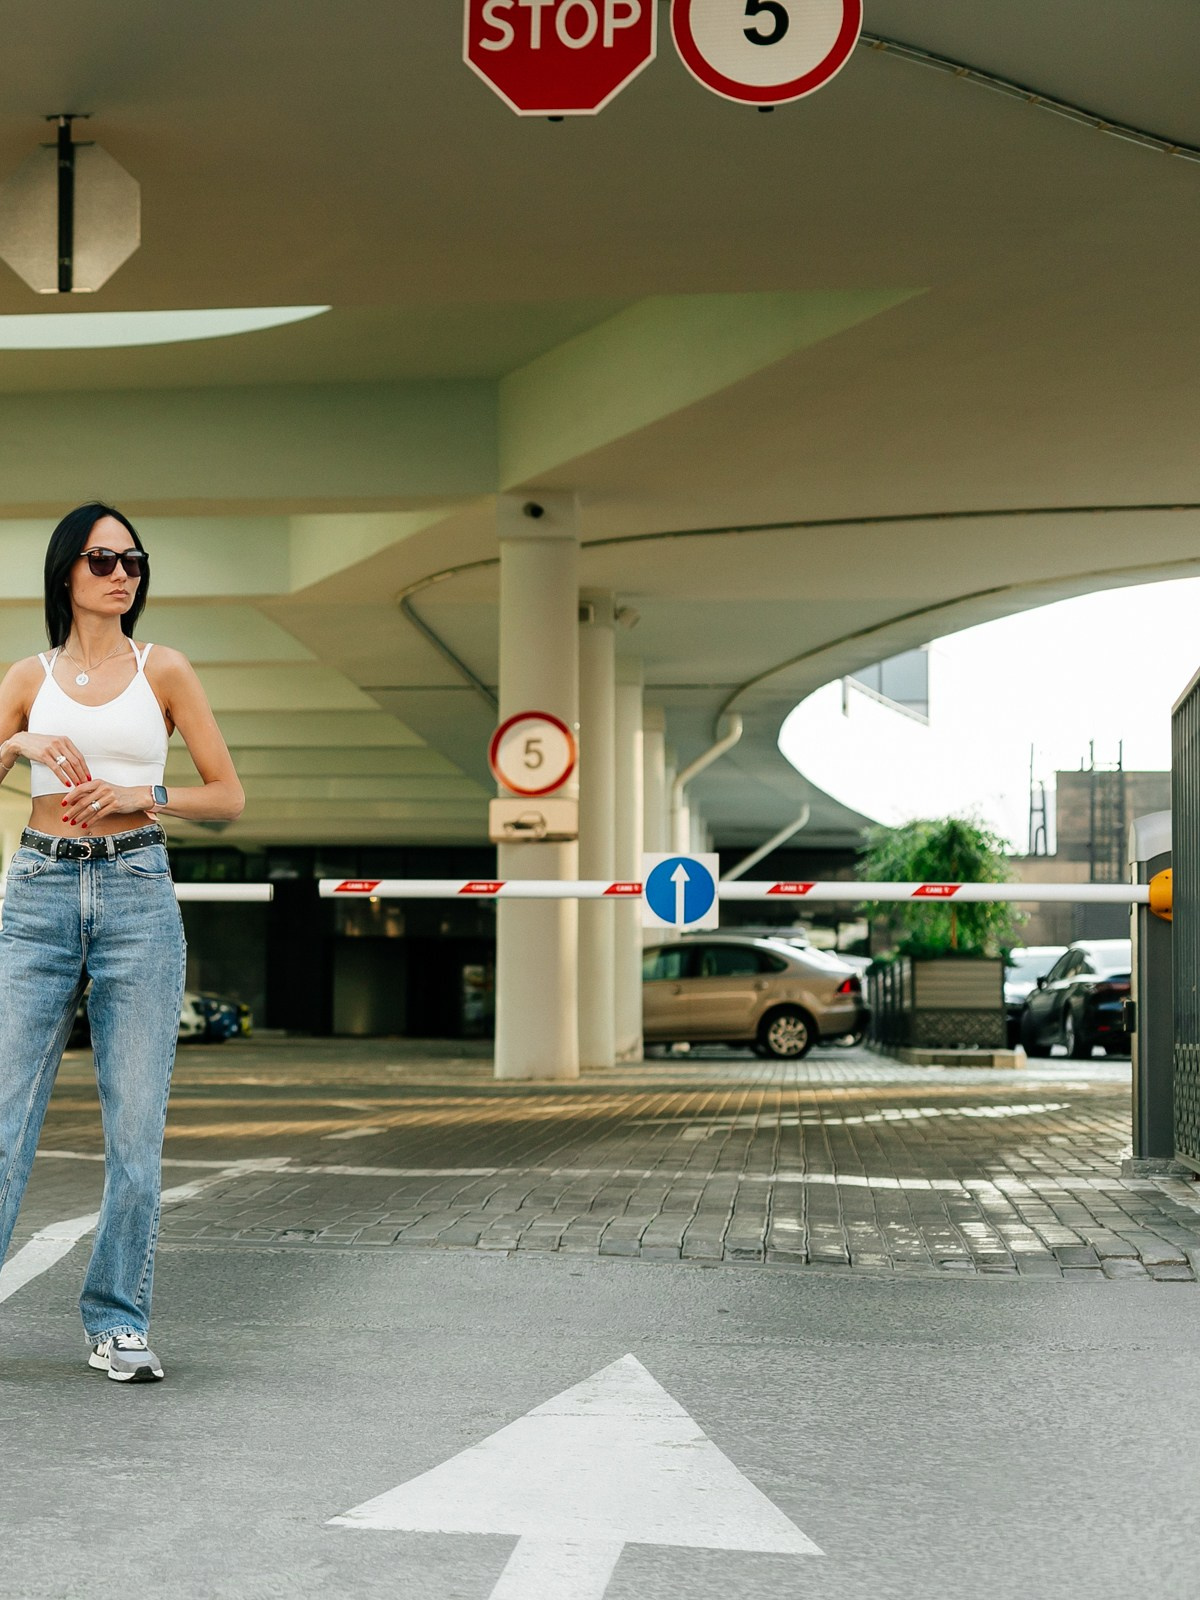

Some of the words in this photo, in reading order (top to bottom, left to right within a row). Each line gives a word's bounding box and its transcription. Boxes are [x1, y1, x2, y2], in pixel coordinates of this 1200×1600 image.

[478, 0, 642, 51] STOP
[743, 0, 790, 46] 5
[524, 738, 544, 769] 5
